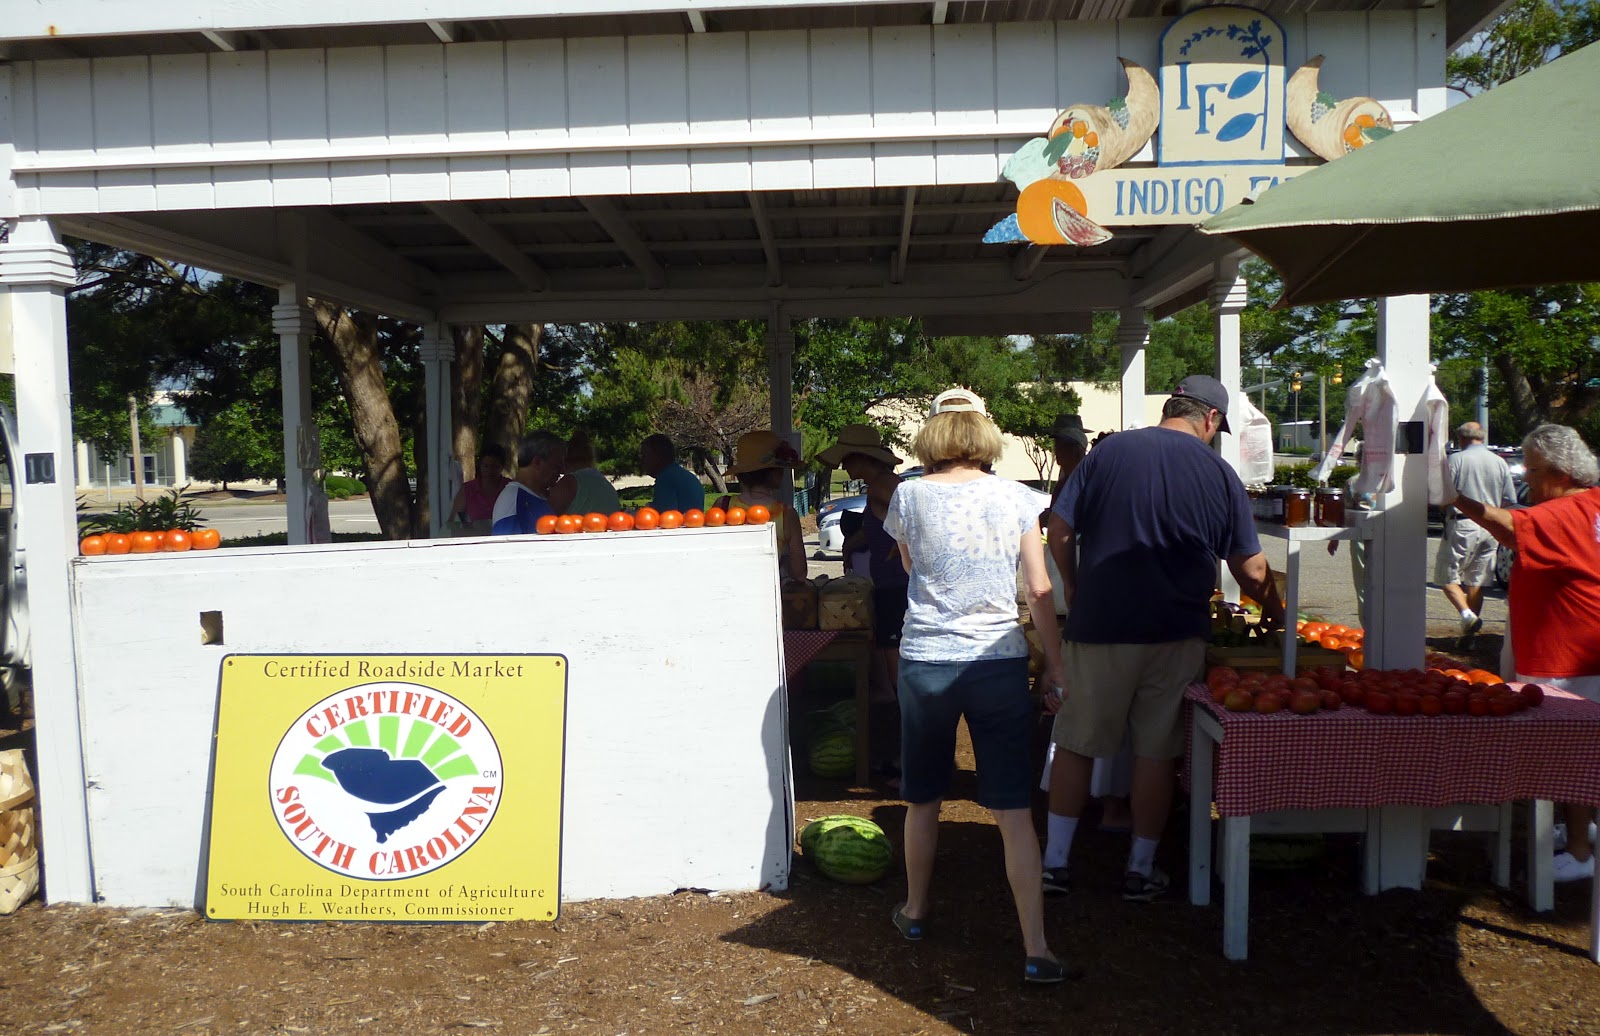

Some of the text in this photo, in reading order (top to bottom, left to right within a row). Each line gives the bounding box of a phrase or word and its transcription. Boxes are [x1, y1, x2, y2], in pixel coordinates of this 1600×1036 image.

[1114, 177, 1225, 216] INDIGO
[29, 456, 54, 480] 10
[263, 660, 524, 678] Certified Roadside Market
[306, 690, 472, 738] CERTIFIED
[482, 770, 497, 779] CM
[276, 785, 497, 875] SOUTH CAROLINA
[221, 883, 545, 901] South Carolina Department of Agriculture
[248, 901, 515, 917] Hugh E. Weathers, Commissioner
